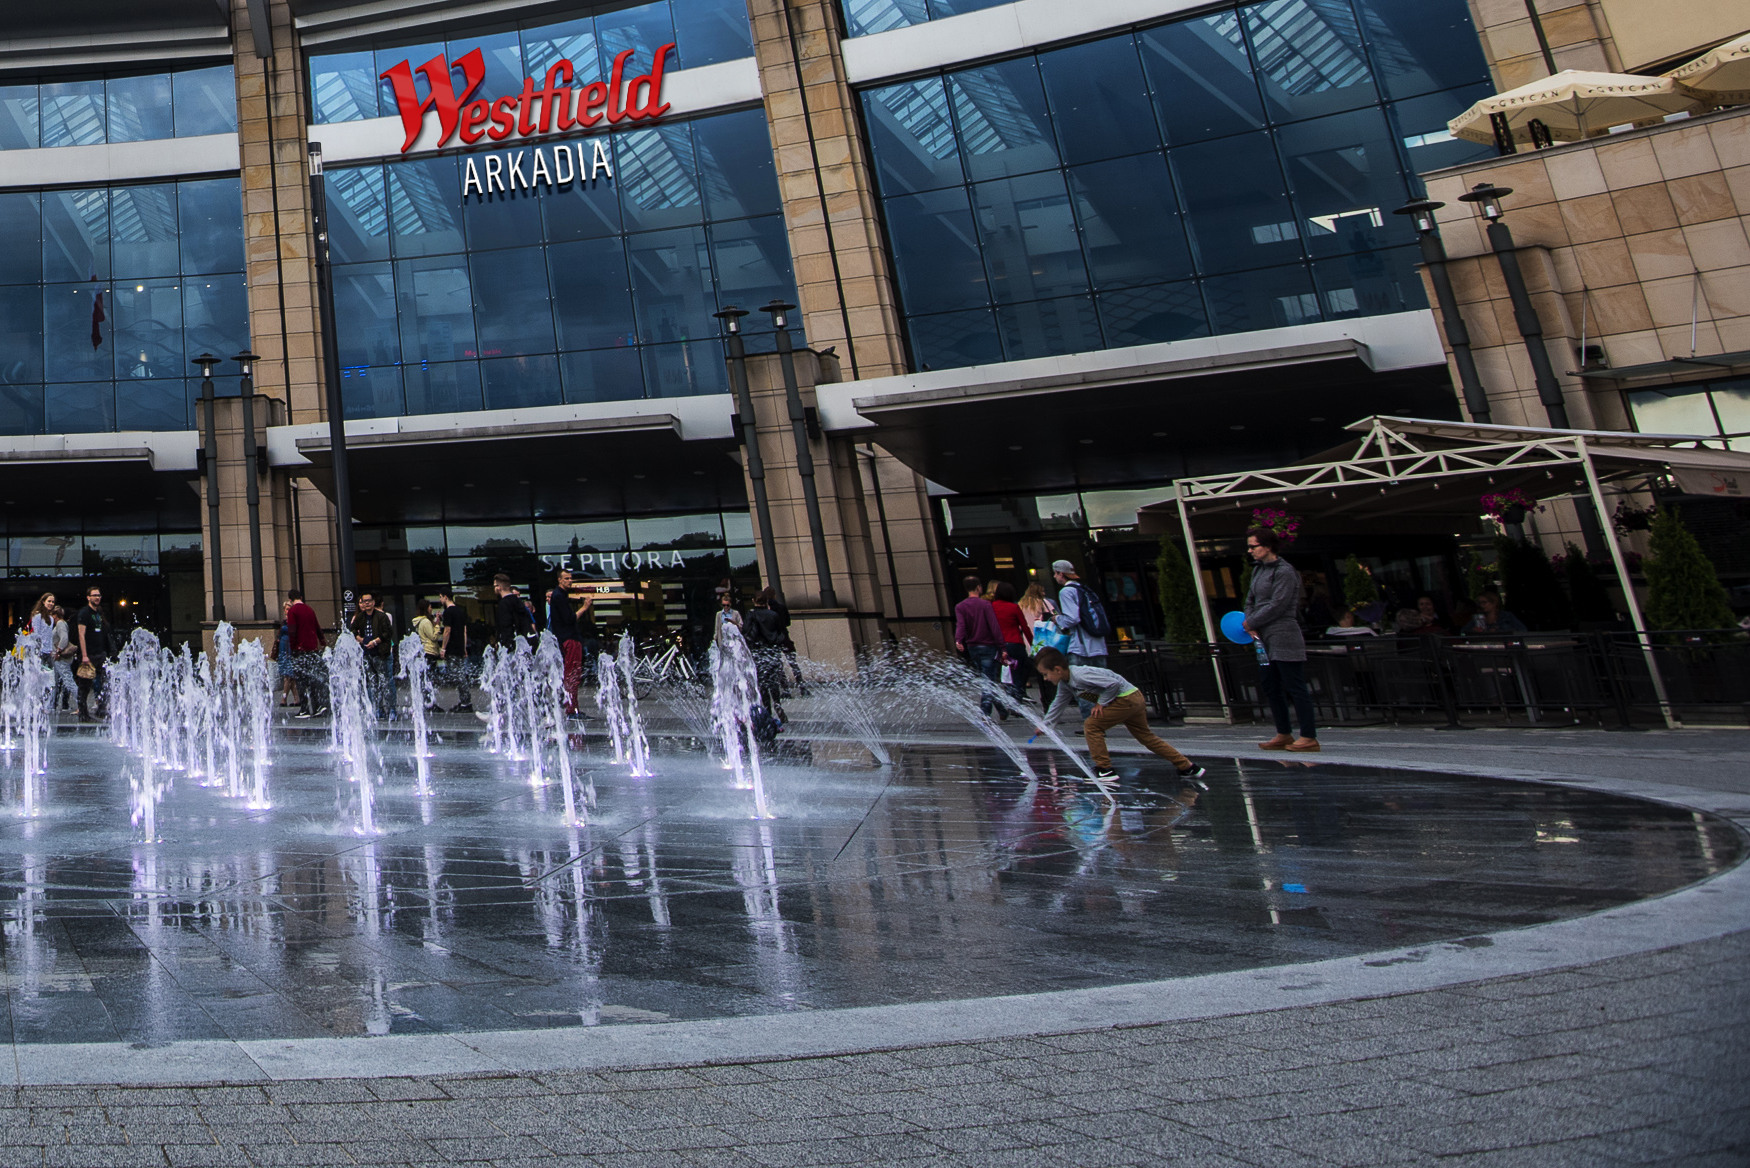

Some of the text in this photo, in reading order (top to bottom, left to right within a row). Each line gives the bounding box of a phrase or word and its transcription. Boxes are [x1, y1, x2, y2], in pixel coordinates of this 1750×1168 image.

[1597, 83, 1661, 93] GRYCAN
[380, 42, 676, 154] Westfield
[1499, 90, 1559, 107] GRYCAN
[463, 140, 613, 197] ARKADIA
[542, 550, 686, 572] SEPHORA
[596, 586, 610, 594] HUB
